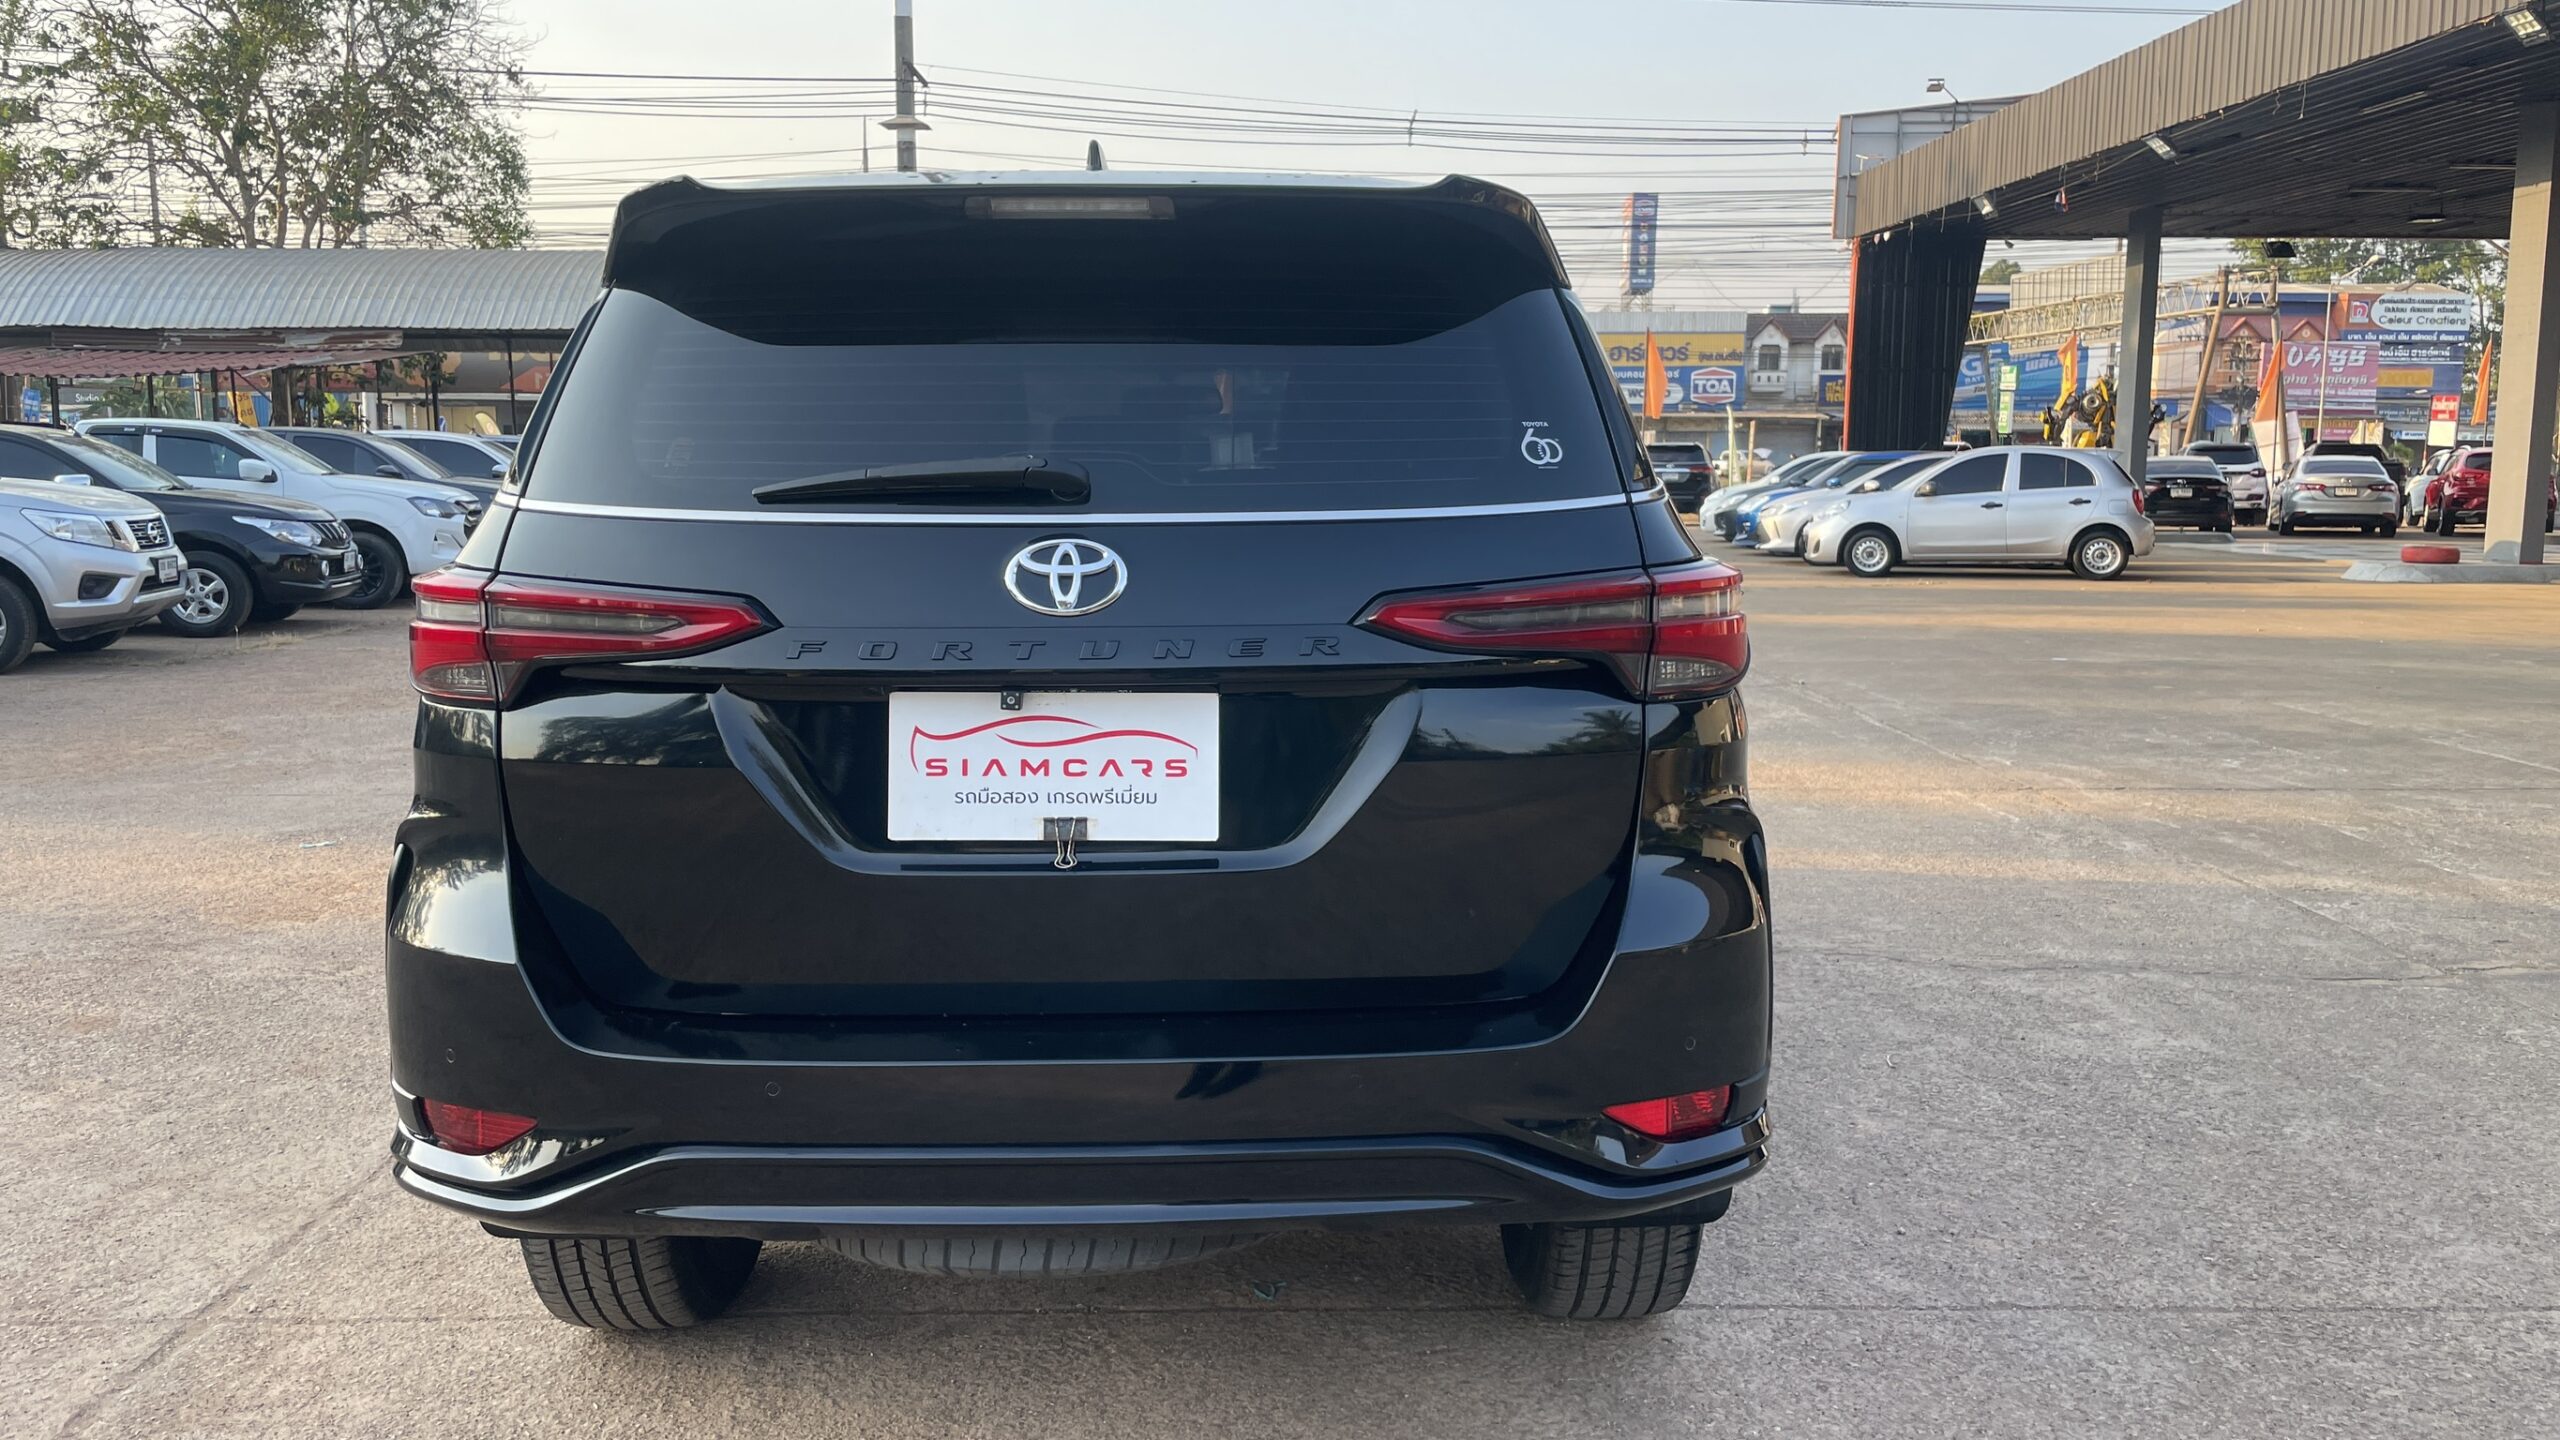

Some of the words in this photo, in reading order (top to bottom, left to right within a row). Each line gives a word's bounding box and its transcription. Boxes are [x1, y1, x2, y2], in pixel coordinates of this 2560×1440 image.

[2416, 315, 2467, 325] Creations
[1694, 380, 1731, 394] TOA
[786, 636, 1341, 661] FORTUNER
[925, 758, 1188, 778] SIAMCARS
[954, 786, 1039, 805] รถมือสอง
[1047, 784, 1158, 805] เกรดพรีเมี่ยม
